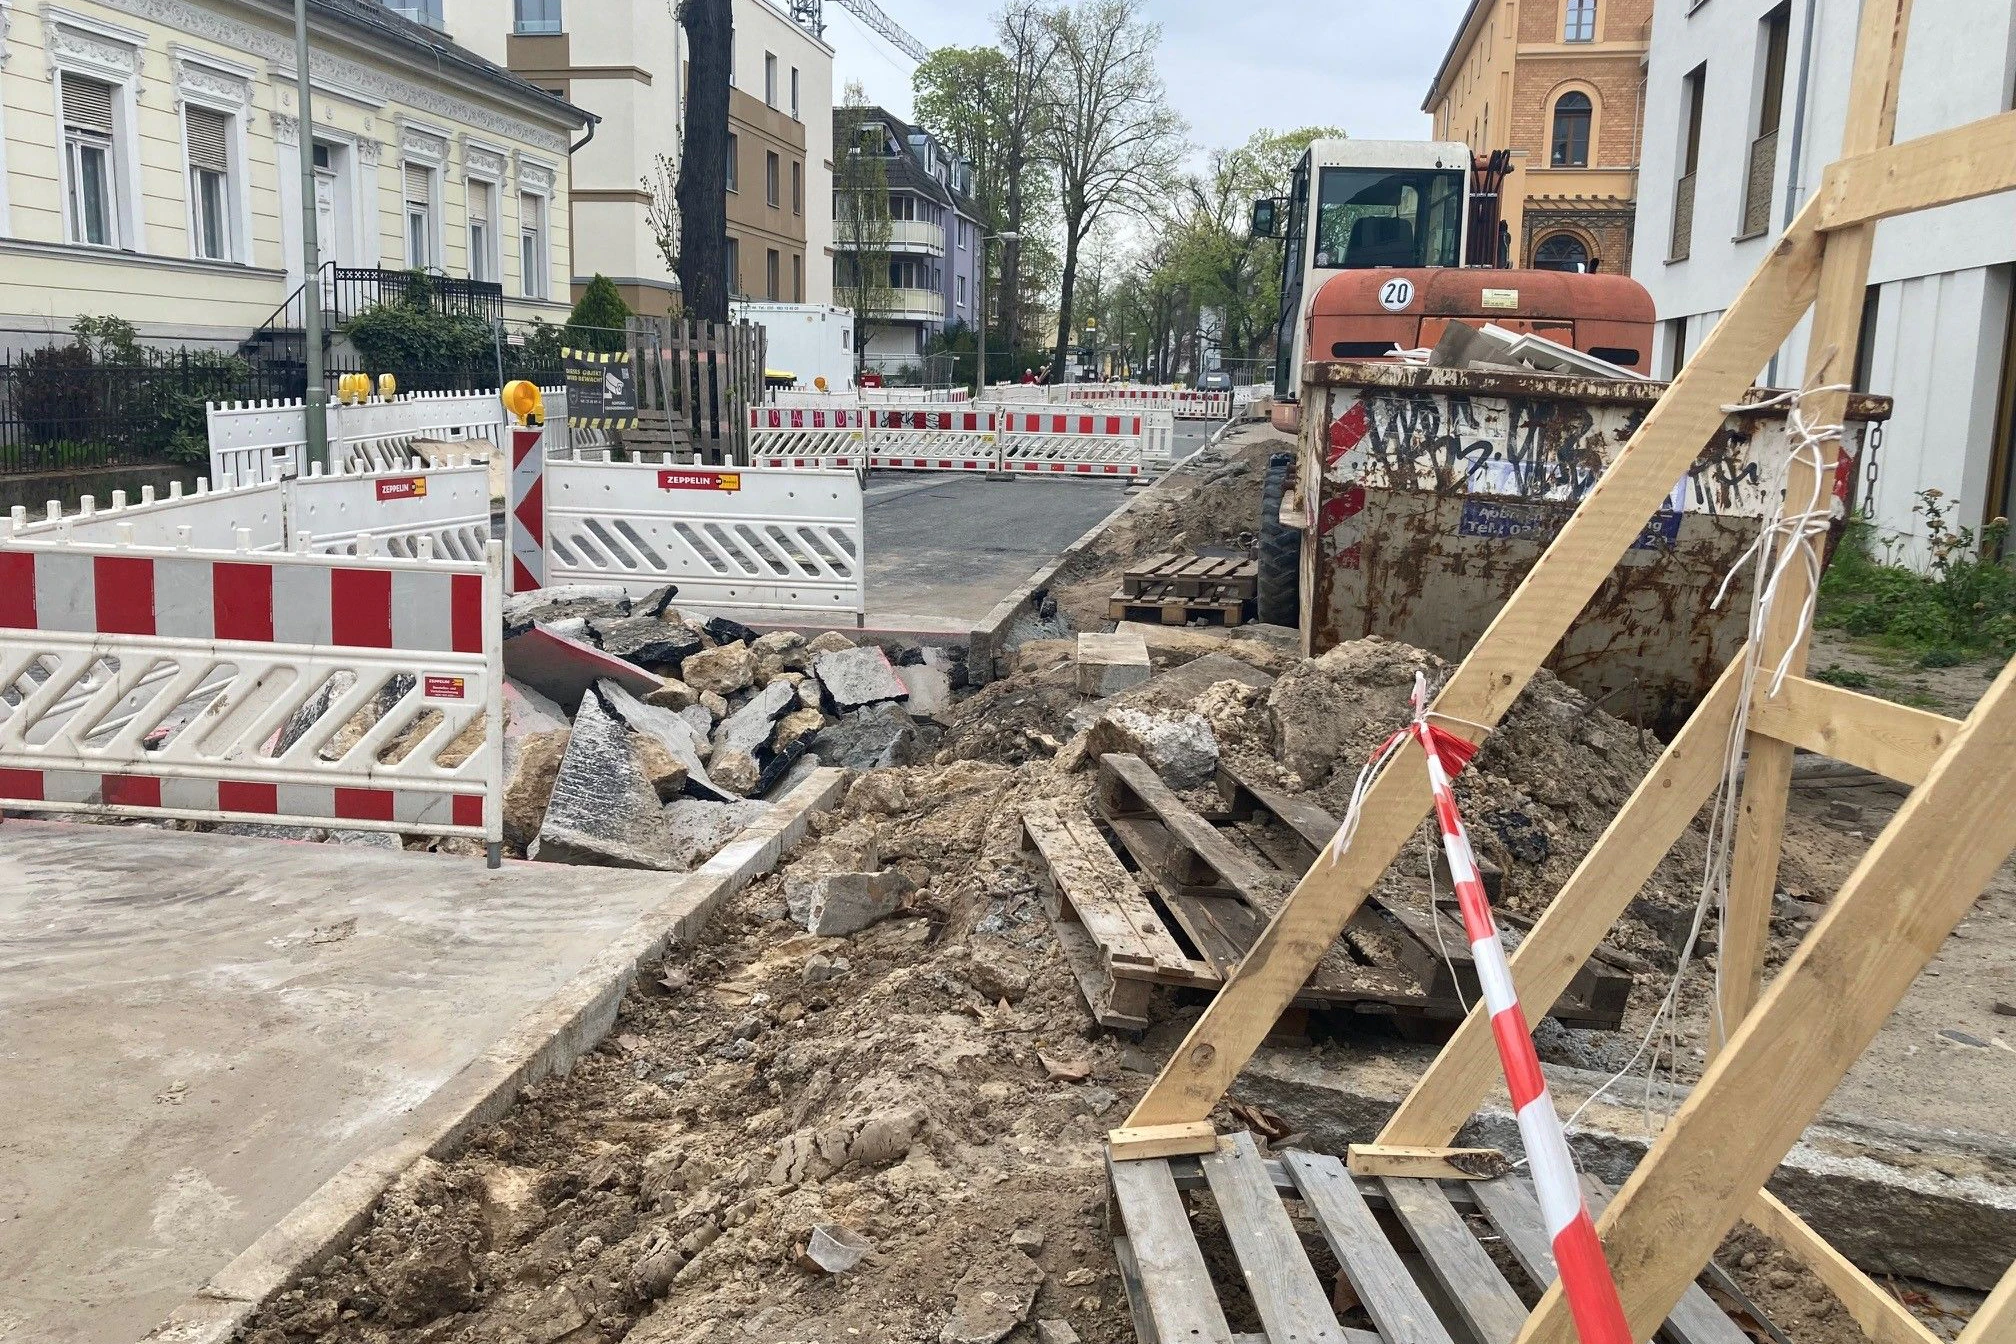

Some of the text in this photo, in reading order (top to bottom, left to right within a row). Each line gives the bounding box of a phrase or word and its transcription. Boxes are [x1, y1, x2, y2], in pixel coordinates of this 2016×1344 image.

[1384, 283, 1408, 304] 20
[667, 476, 711, 485] ZEPPELIN
[382, 484, 409, 493] ZEPPELIN
